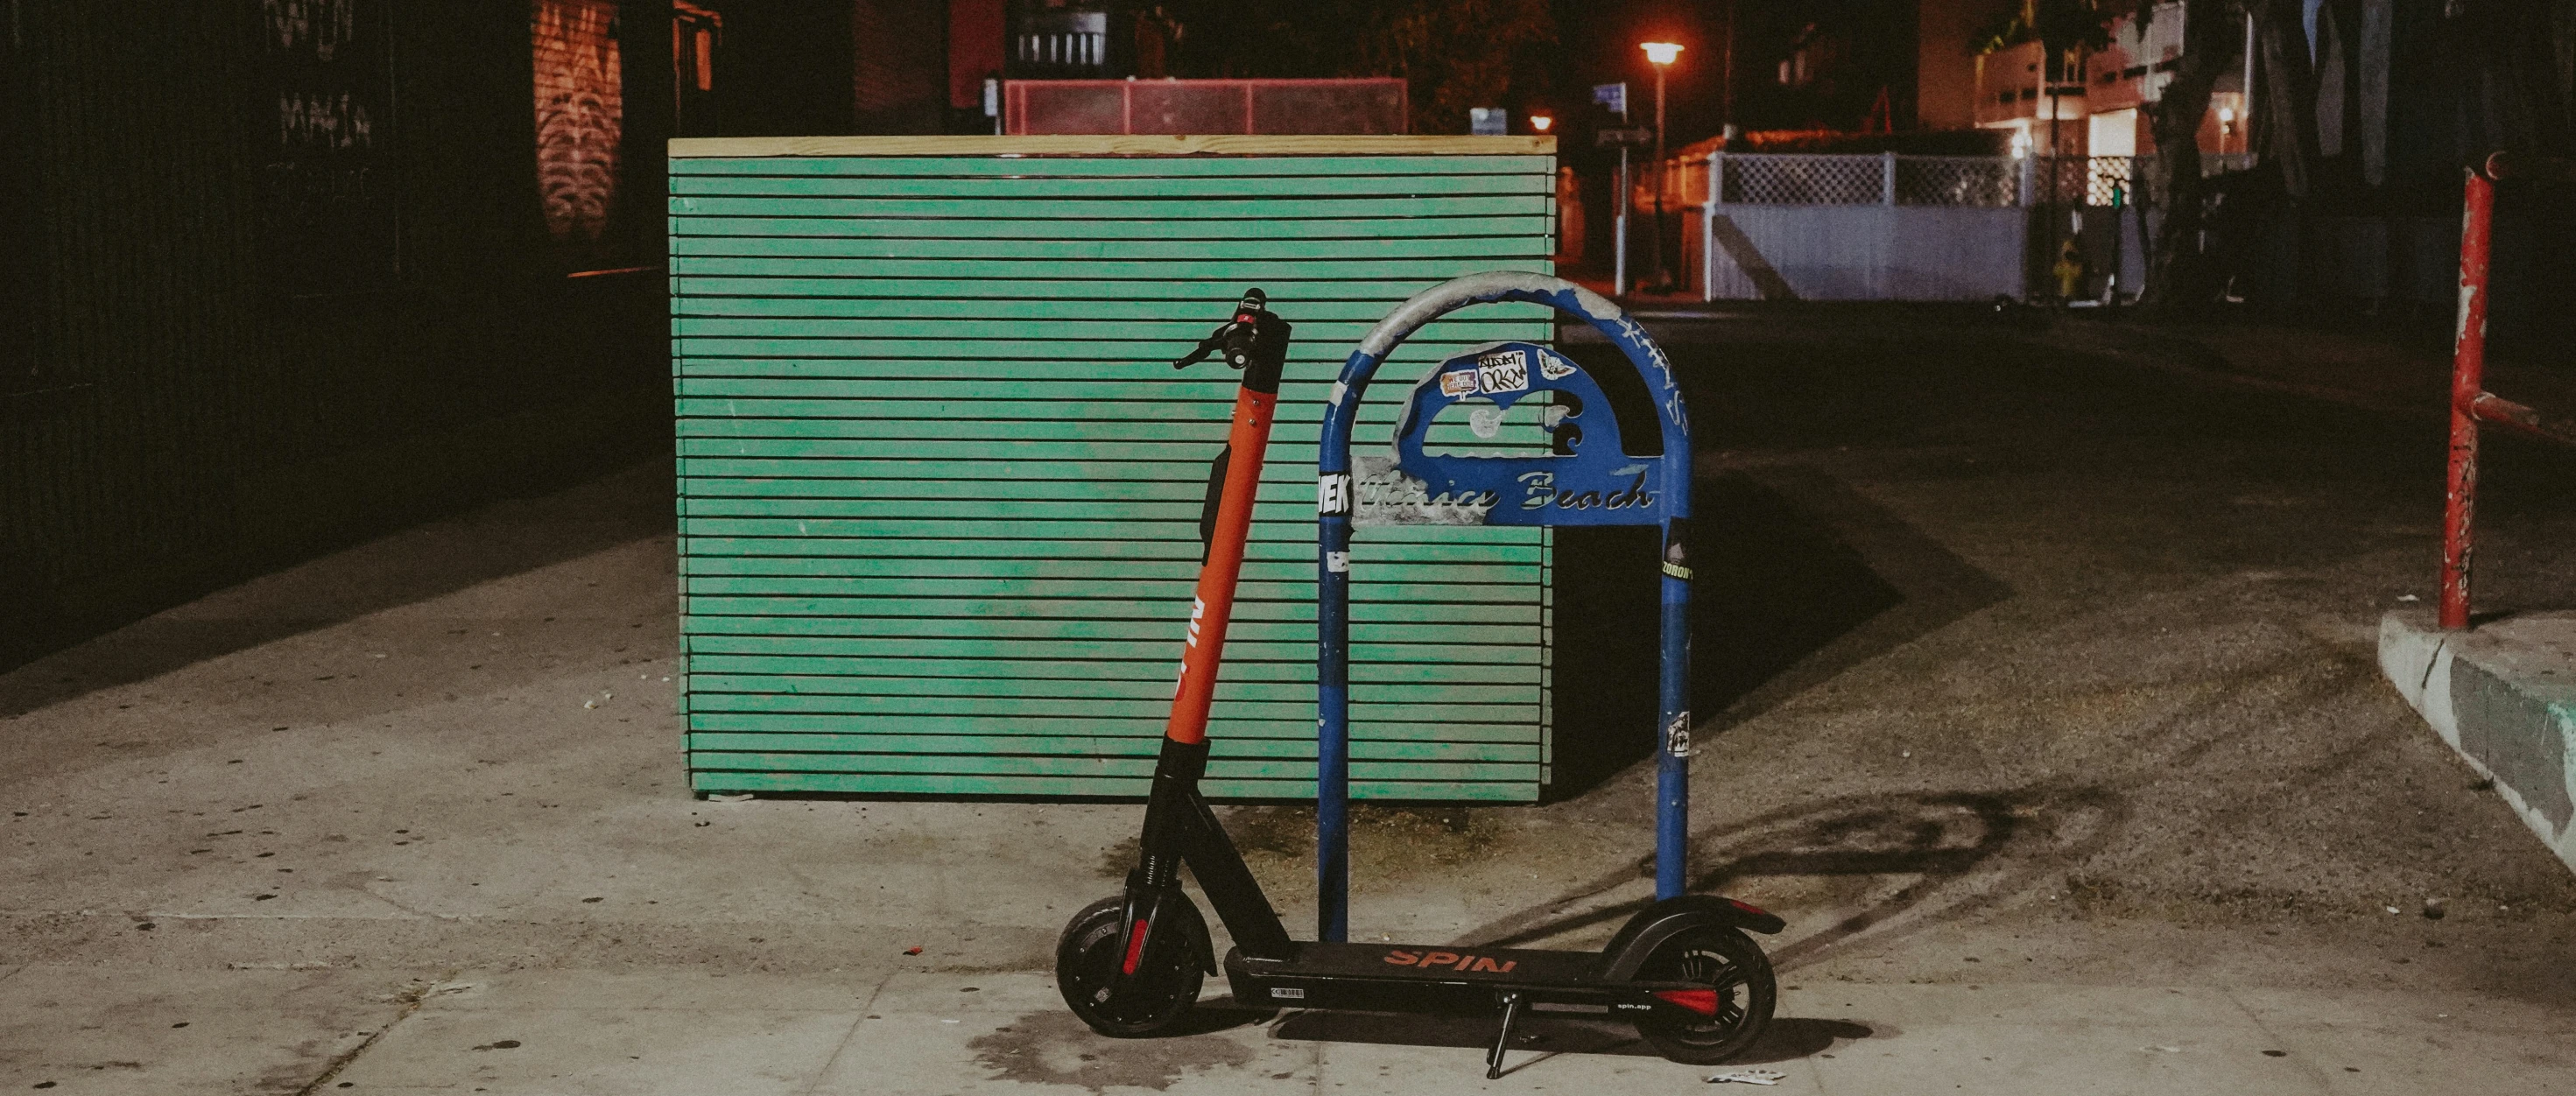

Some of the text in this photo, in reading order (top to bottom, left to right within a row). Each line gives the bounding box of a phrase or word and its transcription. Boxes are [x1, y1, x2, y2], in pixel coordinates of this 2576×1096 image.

[1360, 467, 1655, 511] Venice Beach
[1383, 950, 1517, 973] SPIN
